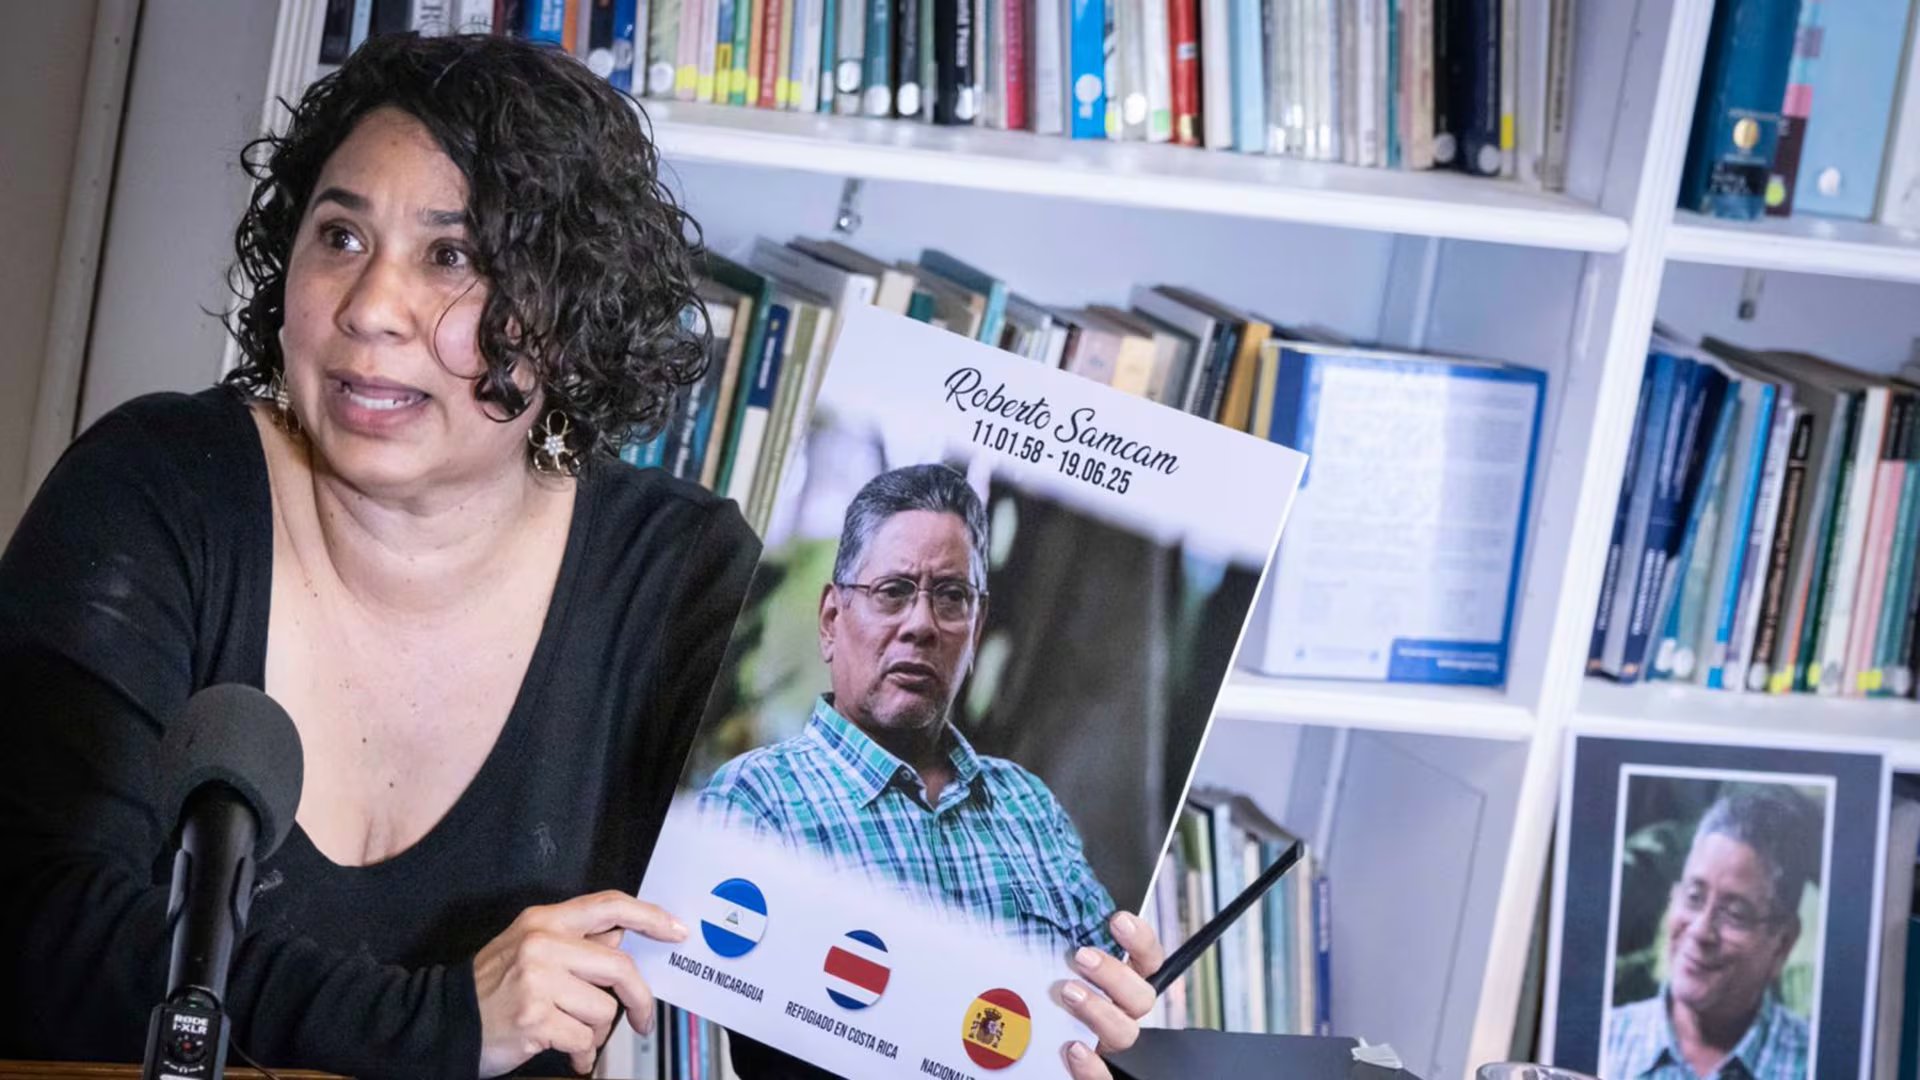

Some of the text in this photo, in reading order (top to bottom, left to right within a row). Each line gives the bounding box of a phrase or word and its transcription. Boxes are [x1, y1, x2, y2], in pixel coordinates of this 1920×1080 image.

[944, 367, 1180, 475] Roberto Samcam
[972, 419, 1045, 463] 11.01.58
[1058, 450, 1133, 494] 19.06.25
[668, 951, 765, 1003] NACIDO EN NICARAGUA
[784, 1001, 899, 1060] REFUGIADO EN COSTA RICA
